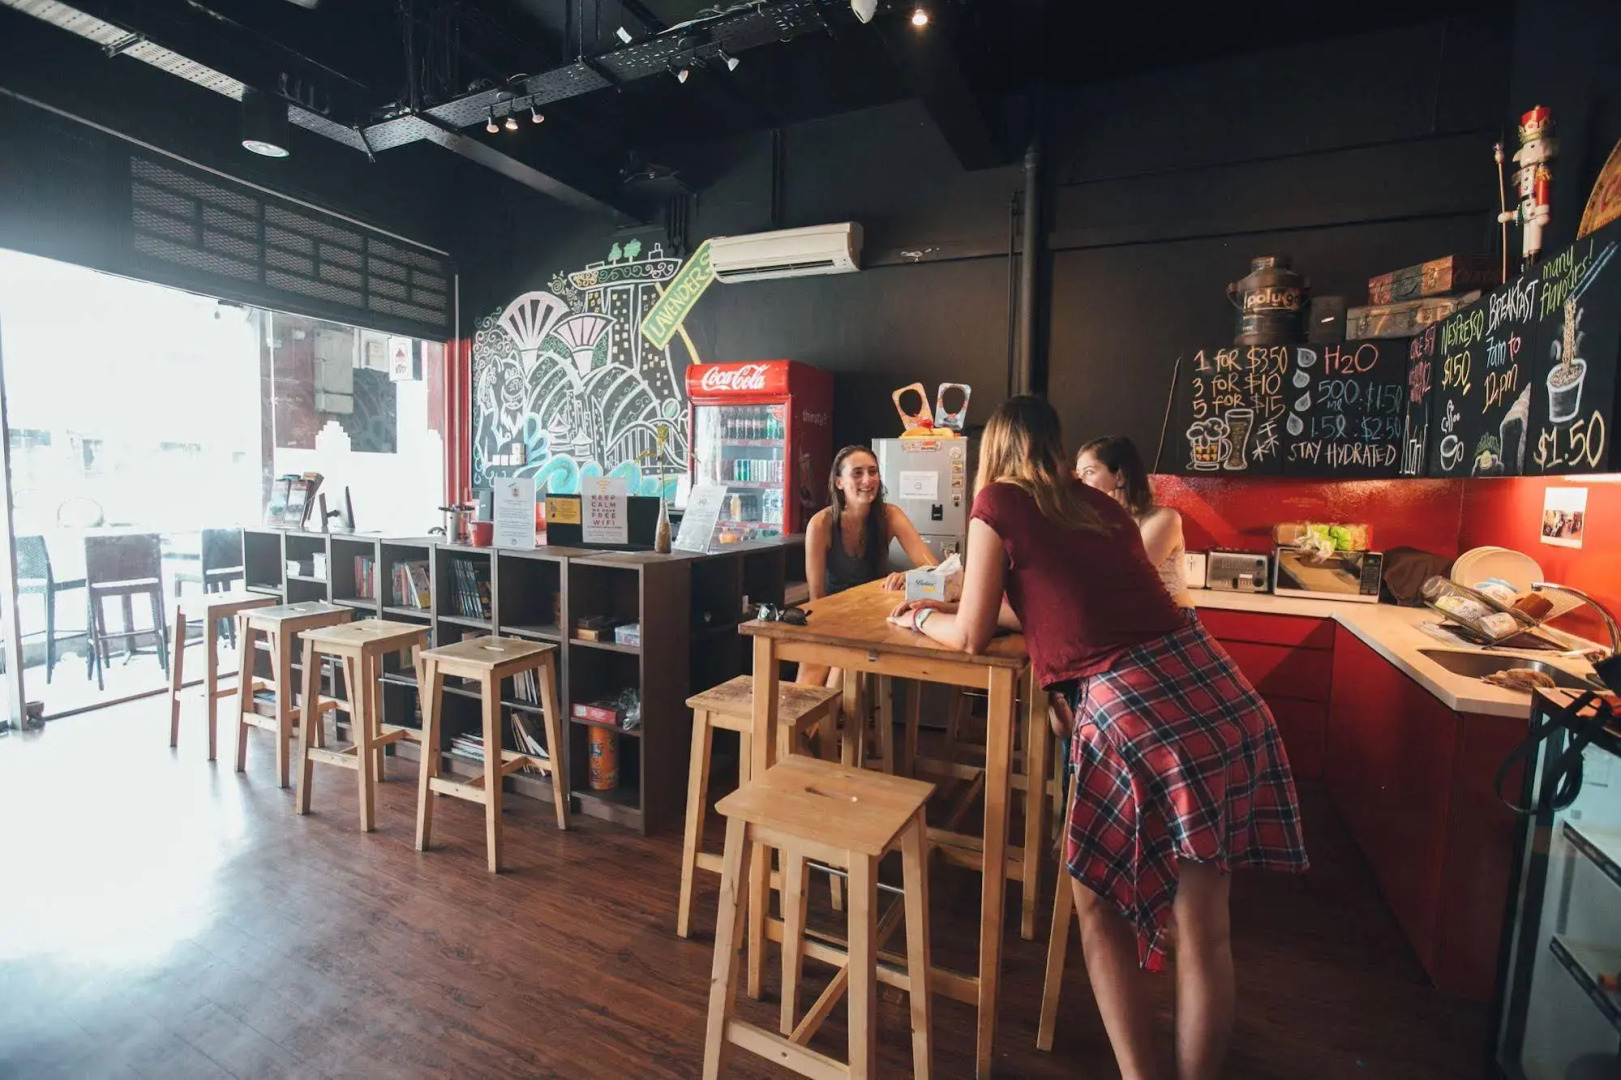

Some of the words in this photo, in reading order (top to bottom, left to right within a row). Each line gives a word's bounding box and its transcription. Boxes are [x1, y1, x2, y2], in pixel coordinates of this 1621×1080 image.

[1542, 244, 1574, 281] many
[648, 267, 709, 339] LAVENDER
[1485, 276, 1539, 336] BREAKFAST
[1440, 309, 1485, 357] NESPRESSO
[1485, 336, 1507, 369] 7am
[1507, 330, 1521, 362] to
[1193, 349, 1212, 372] 1
[1324, 343, 1379, 376] H2O
[701, 364, 771, 391] Coca-Cola
[1192, 377, 1204, 398] 3
[1243, 372, 1281, 396] $10
[1193, 398, 1208, 419] 5
[1249, 392, 1286, 421] $15
[1288, 440, 1322, 464] STAY
[1324, 442, 1396, 468] HYDRATED
[1533, 409, 1605, 472] $1.50
